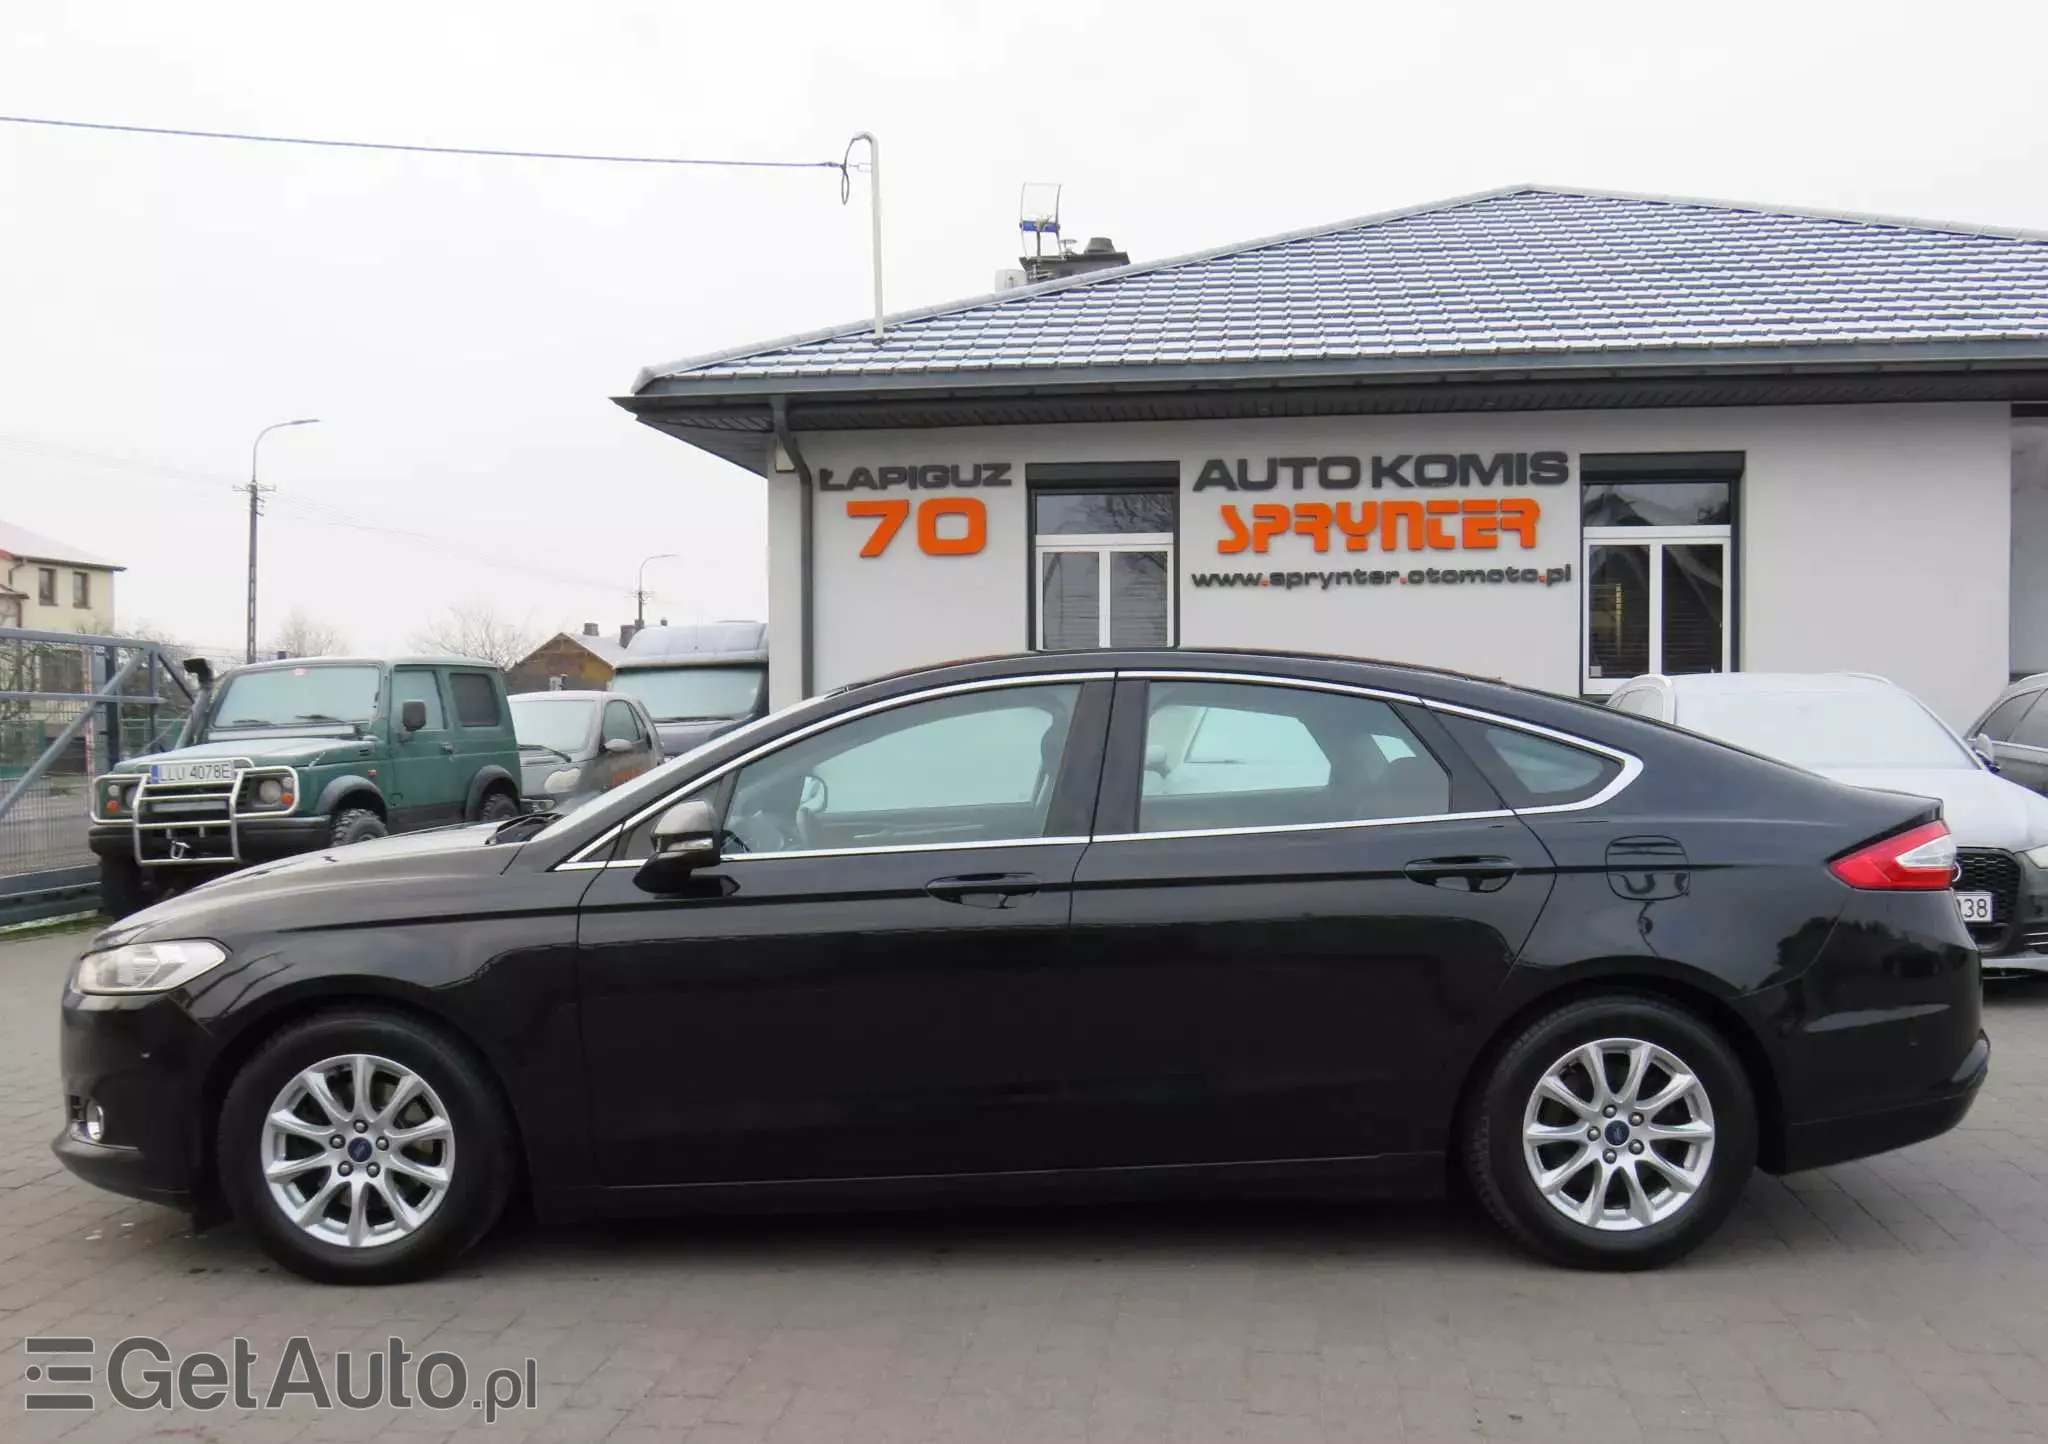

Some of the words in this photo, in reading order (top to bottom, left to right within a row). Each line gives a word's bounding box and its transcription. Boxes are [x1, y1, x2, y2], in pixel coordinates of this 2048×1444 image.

[819, 463, 1012, 491] ŁAPIGUZ
[1192, 456, 1361, 492] AUTO
[1371, 451, 1569, 489] KOMIS
[846, 496, 988, 558] 70
[1217, 498, 1541, 555] SPRYNTER
[1191, 563, 1572, 590] www.sprynter.otomoto.pl
